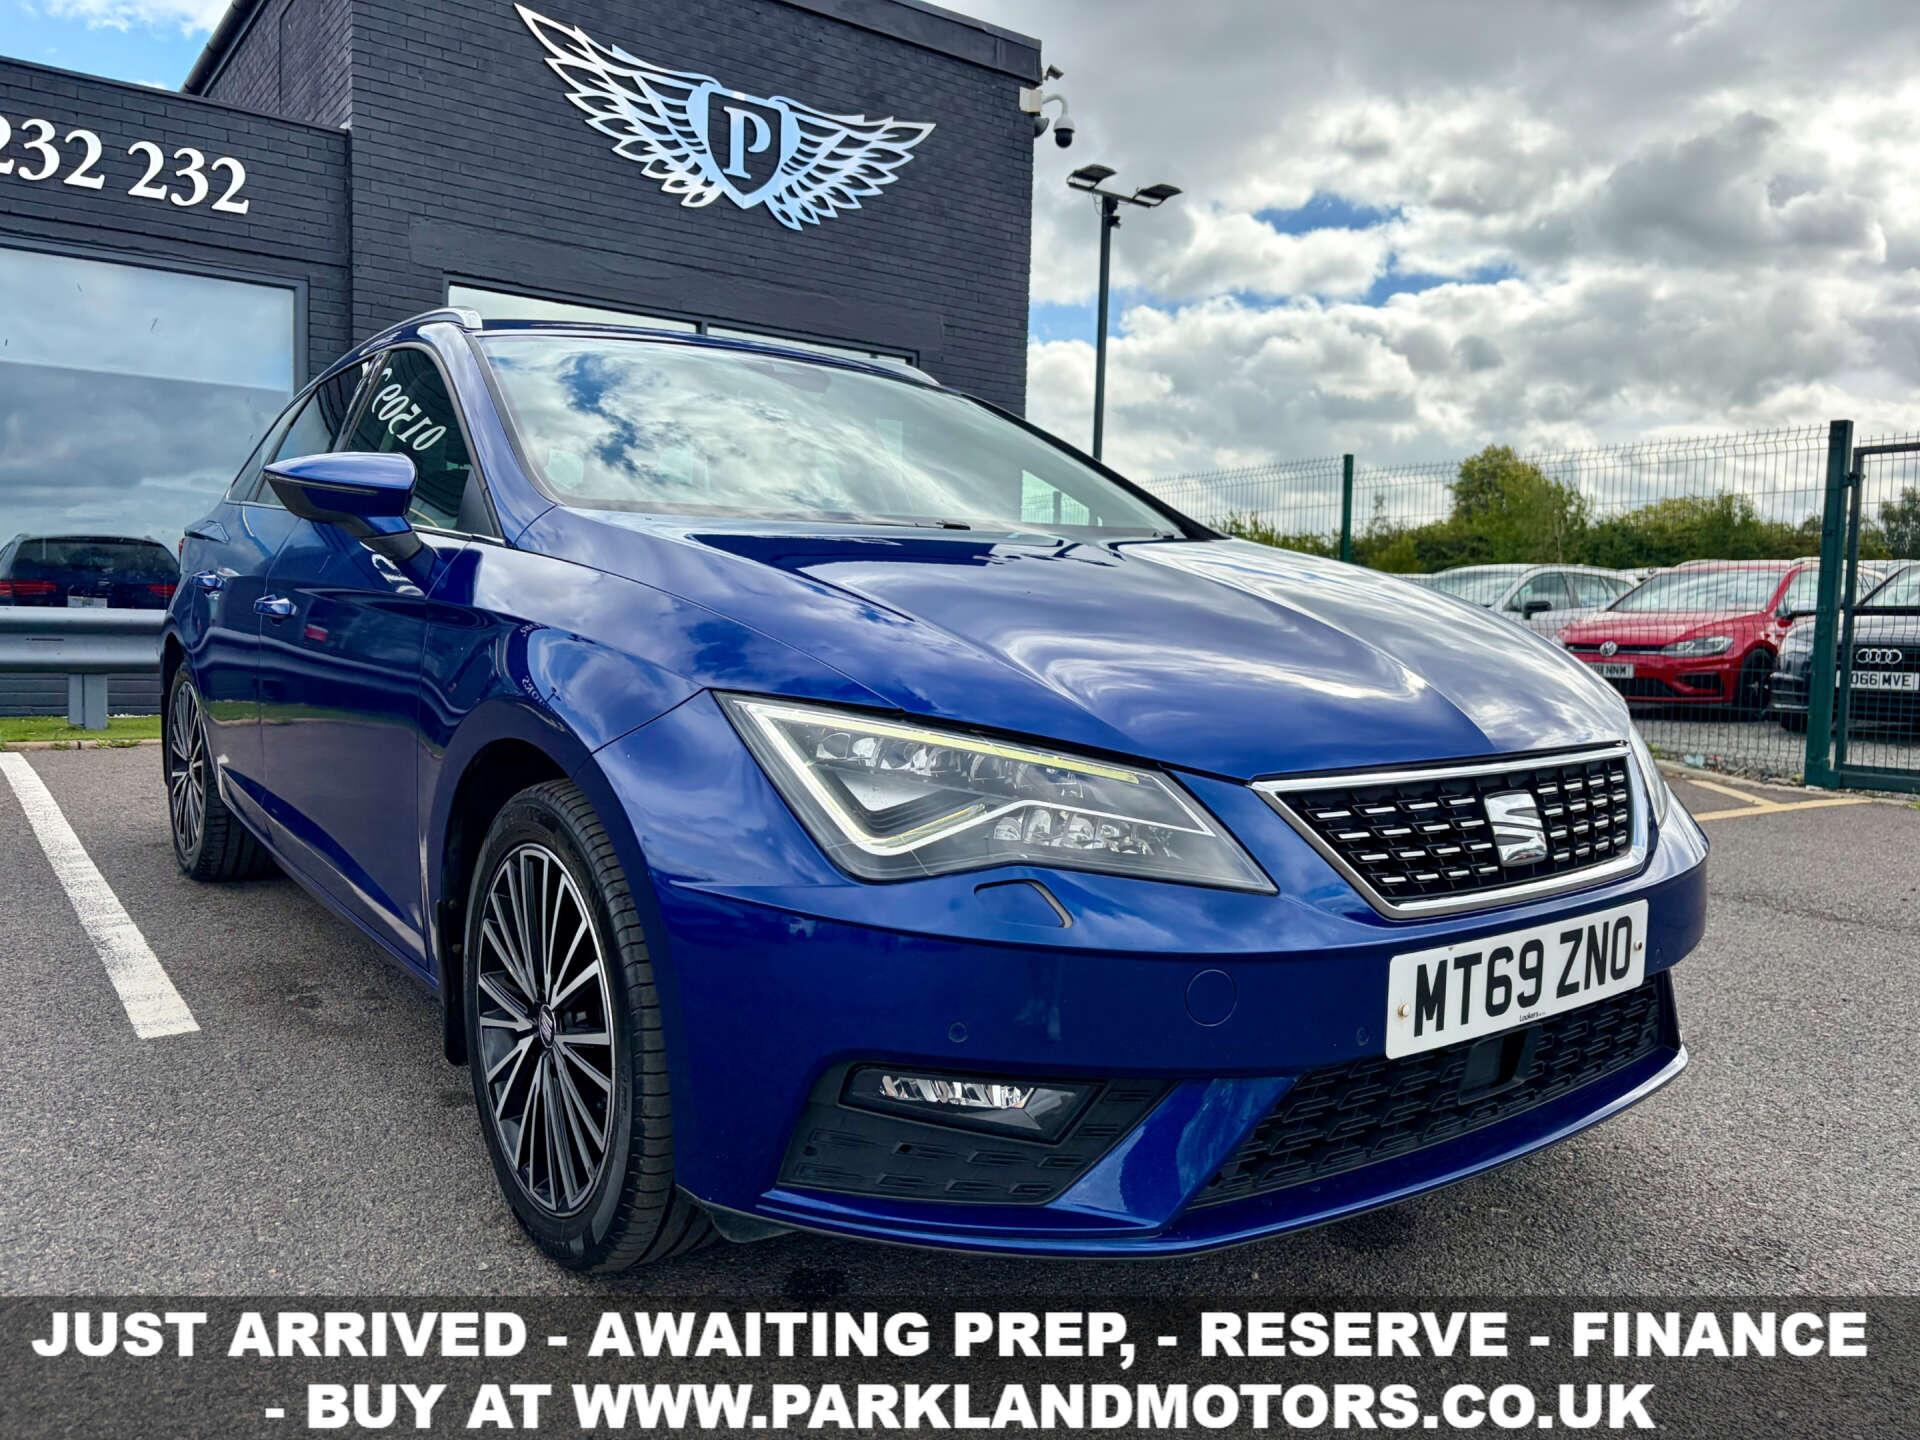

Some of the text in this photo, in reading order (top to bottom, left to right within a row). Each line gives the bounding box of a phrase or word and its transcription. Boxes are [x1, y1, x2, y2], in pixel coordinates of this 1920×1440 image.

[128, 141, 249, 214] 232
[1882, 673, 1912, 687] MVE
[1413, 915, 1633, 1038] MT69 ZNO
